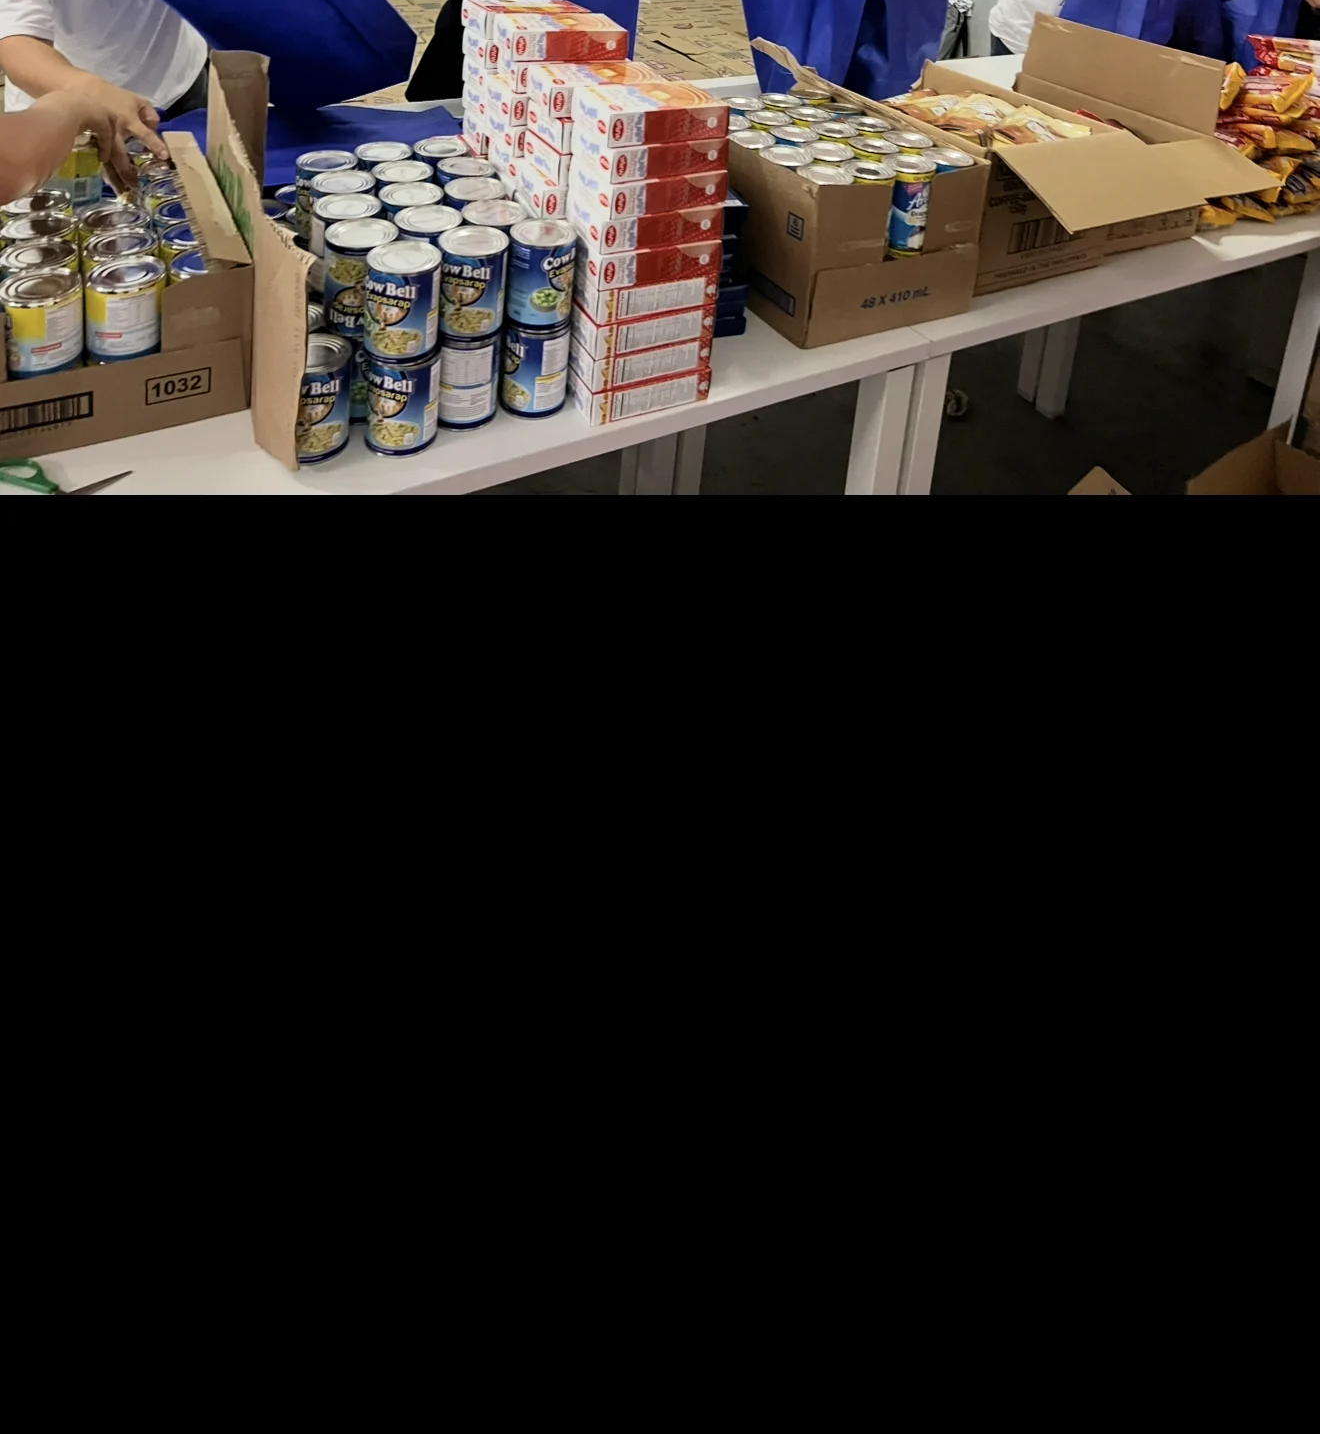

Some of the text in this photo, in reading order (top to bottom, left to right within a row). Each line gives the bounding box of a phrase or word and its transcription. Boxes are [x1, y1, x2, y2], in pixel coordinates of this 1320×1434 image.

[462, 265, 490, 279] Bell
[386, 282, 415, 299] Bell
[878, 294, 887, 305] X
[889, 290, 911, 303] 410
[152, 375, 202, 397] 1032
[310, 379, 340, 395] Bell
[383, 375, 412, 393] Bell
